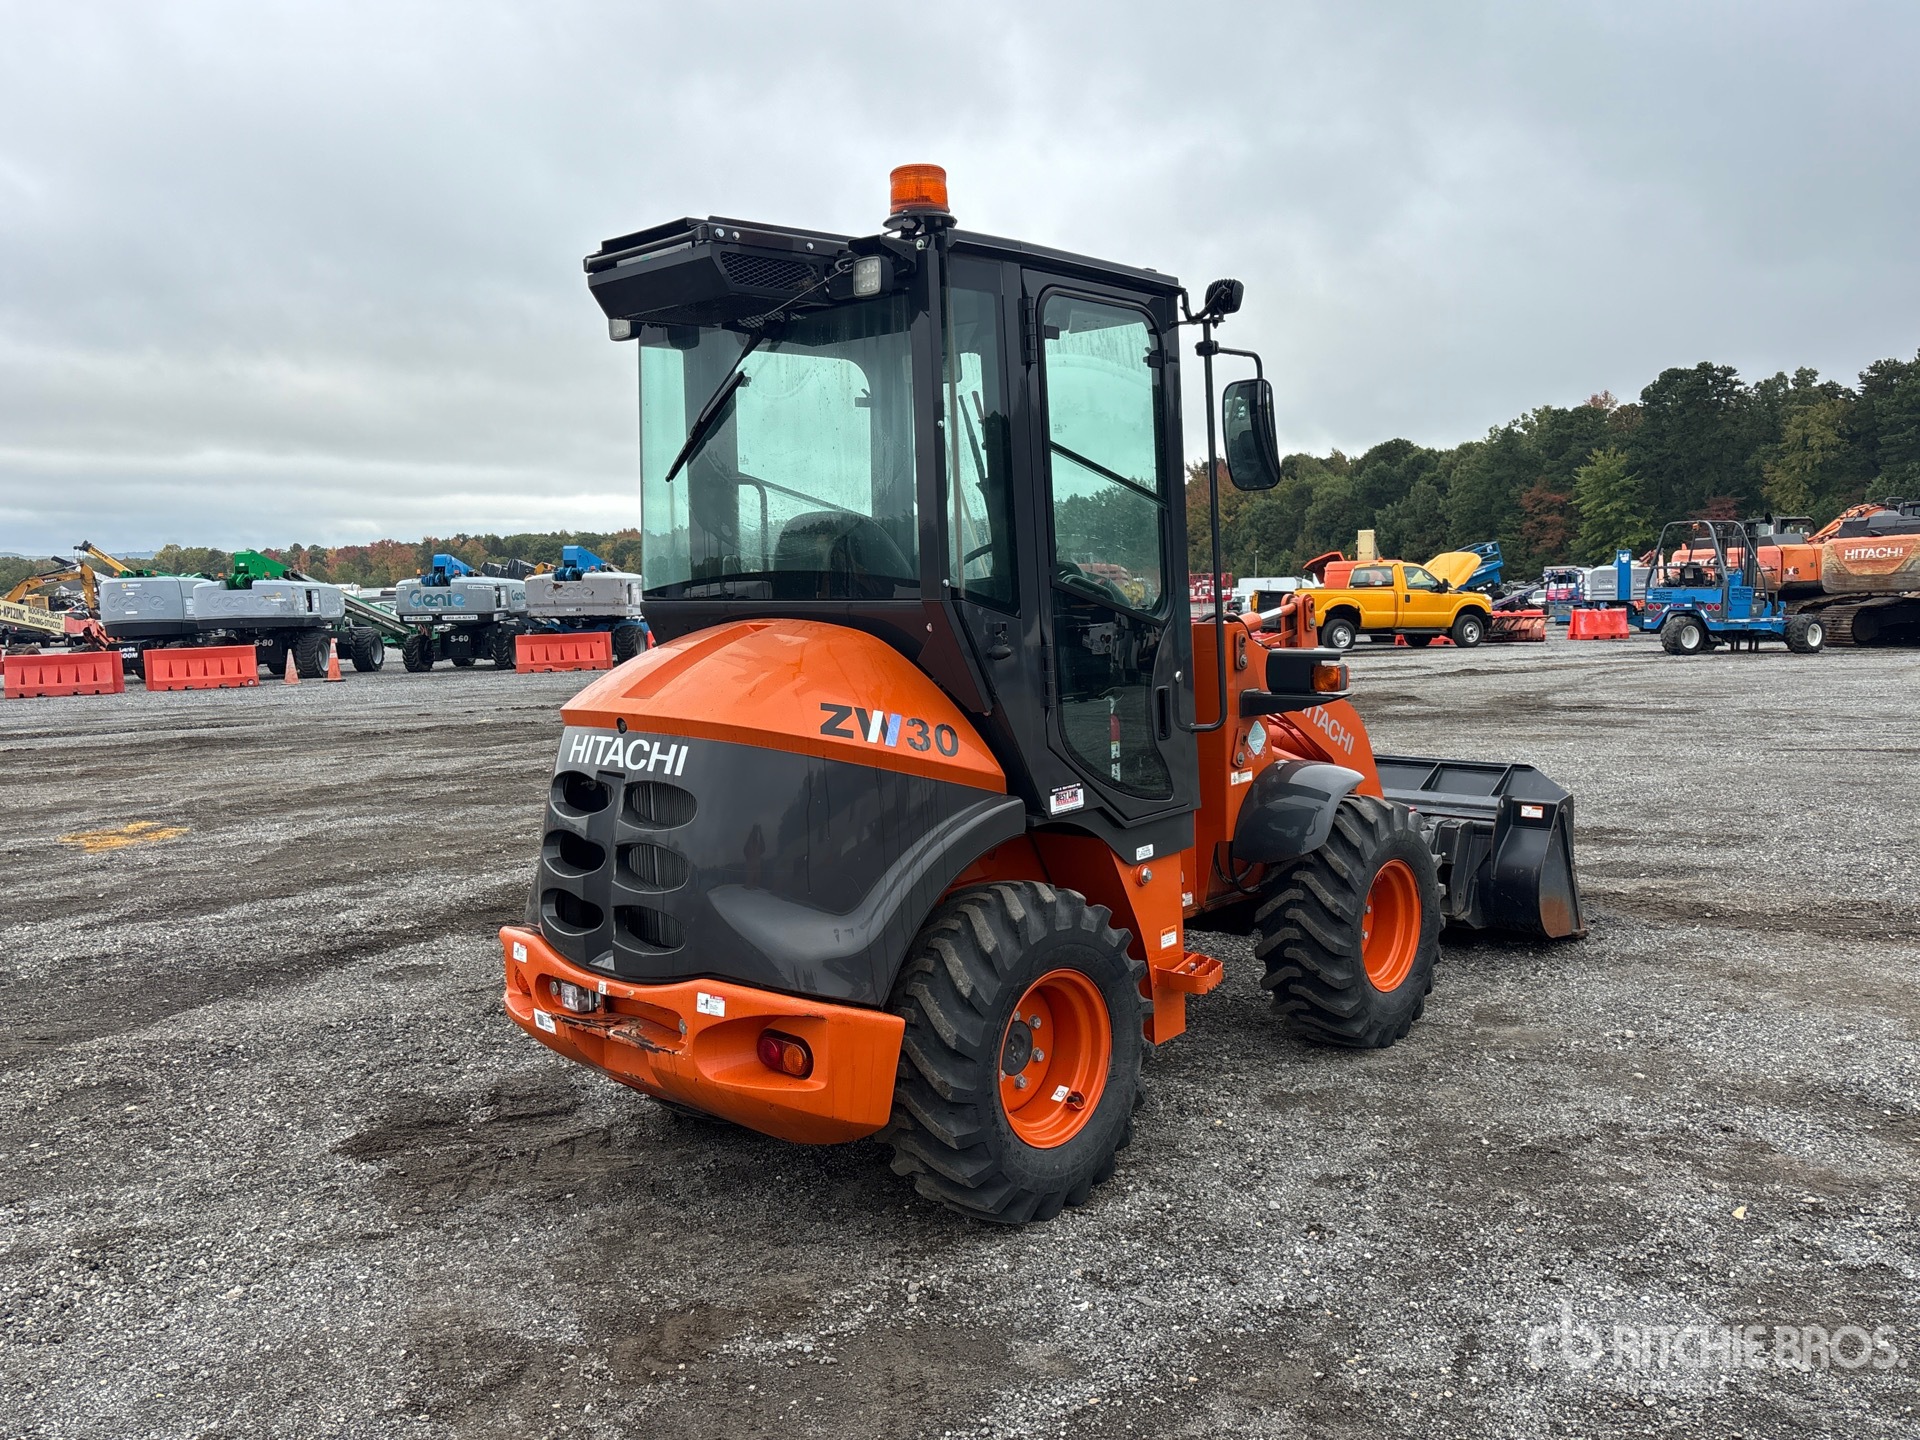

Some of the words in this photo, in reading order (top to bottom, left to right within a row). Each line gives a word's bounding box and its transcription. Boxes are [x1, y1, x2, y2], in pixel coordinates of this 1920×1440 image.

[1844, 547, 1905, 560] HITACHI
[408, 589, 466, 609] Genie
[253, 638, 274, 647] S-80
[450, 634, 469, 643] S-60
[1302, 705, 1355, 756] ITACHI
[568, 734, 689, 777] HITACHI
